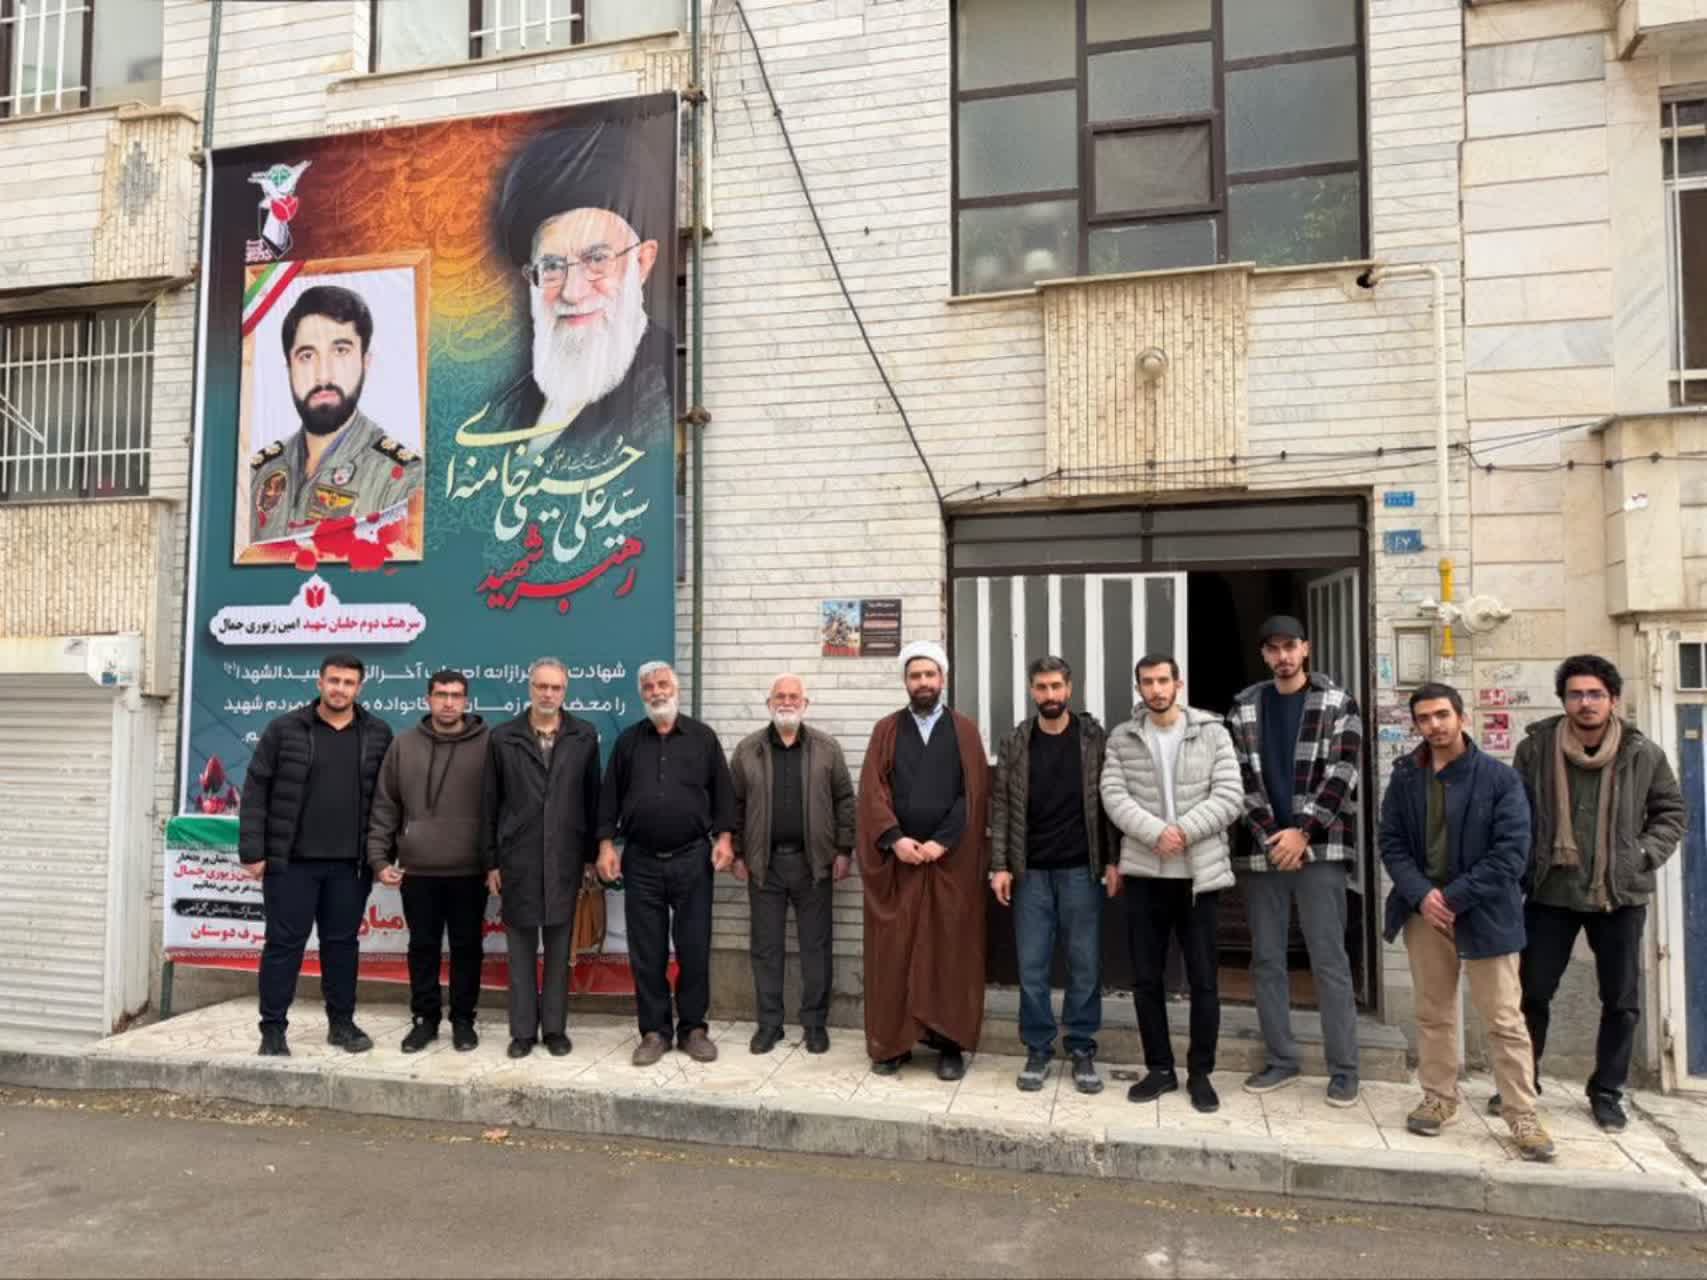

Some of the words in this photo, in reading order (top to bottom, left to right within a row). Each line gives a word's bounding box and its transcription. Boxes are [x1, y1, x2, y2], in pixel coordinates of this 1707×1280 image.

[552, 480, 607, 563] علی
[477, 522, 545, 609] شهید
[506, 537, 645, 615] رهبر
[303, 617, 327, 633] شهید
[568, 660, 626, 684] شهادت
[223, 694, 264, 715] شهید
[562, 697, 612, 712] محض
[615, 696, 625, 716] را
[359, 905, 404, 936] مبار
[191, 923, 235, 942] دوستان
